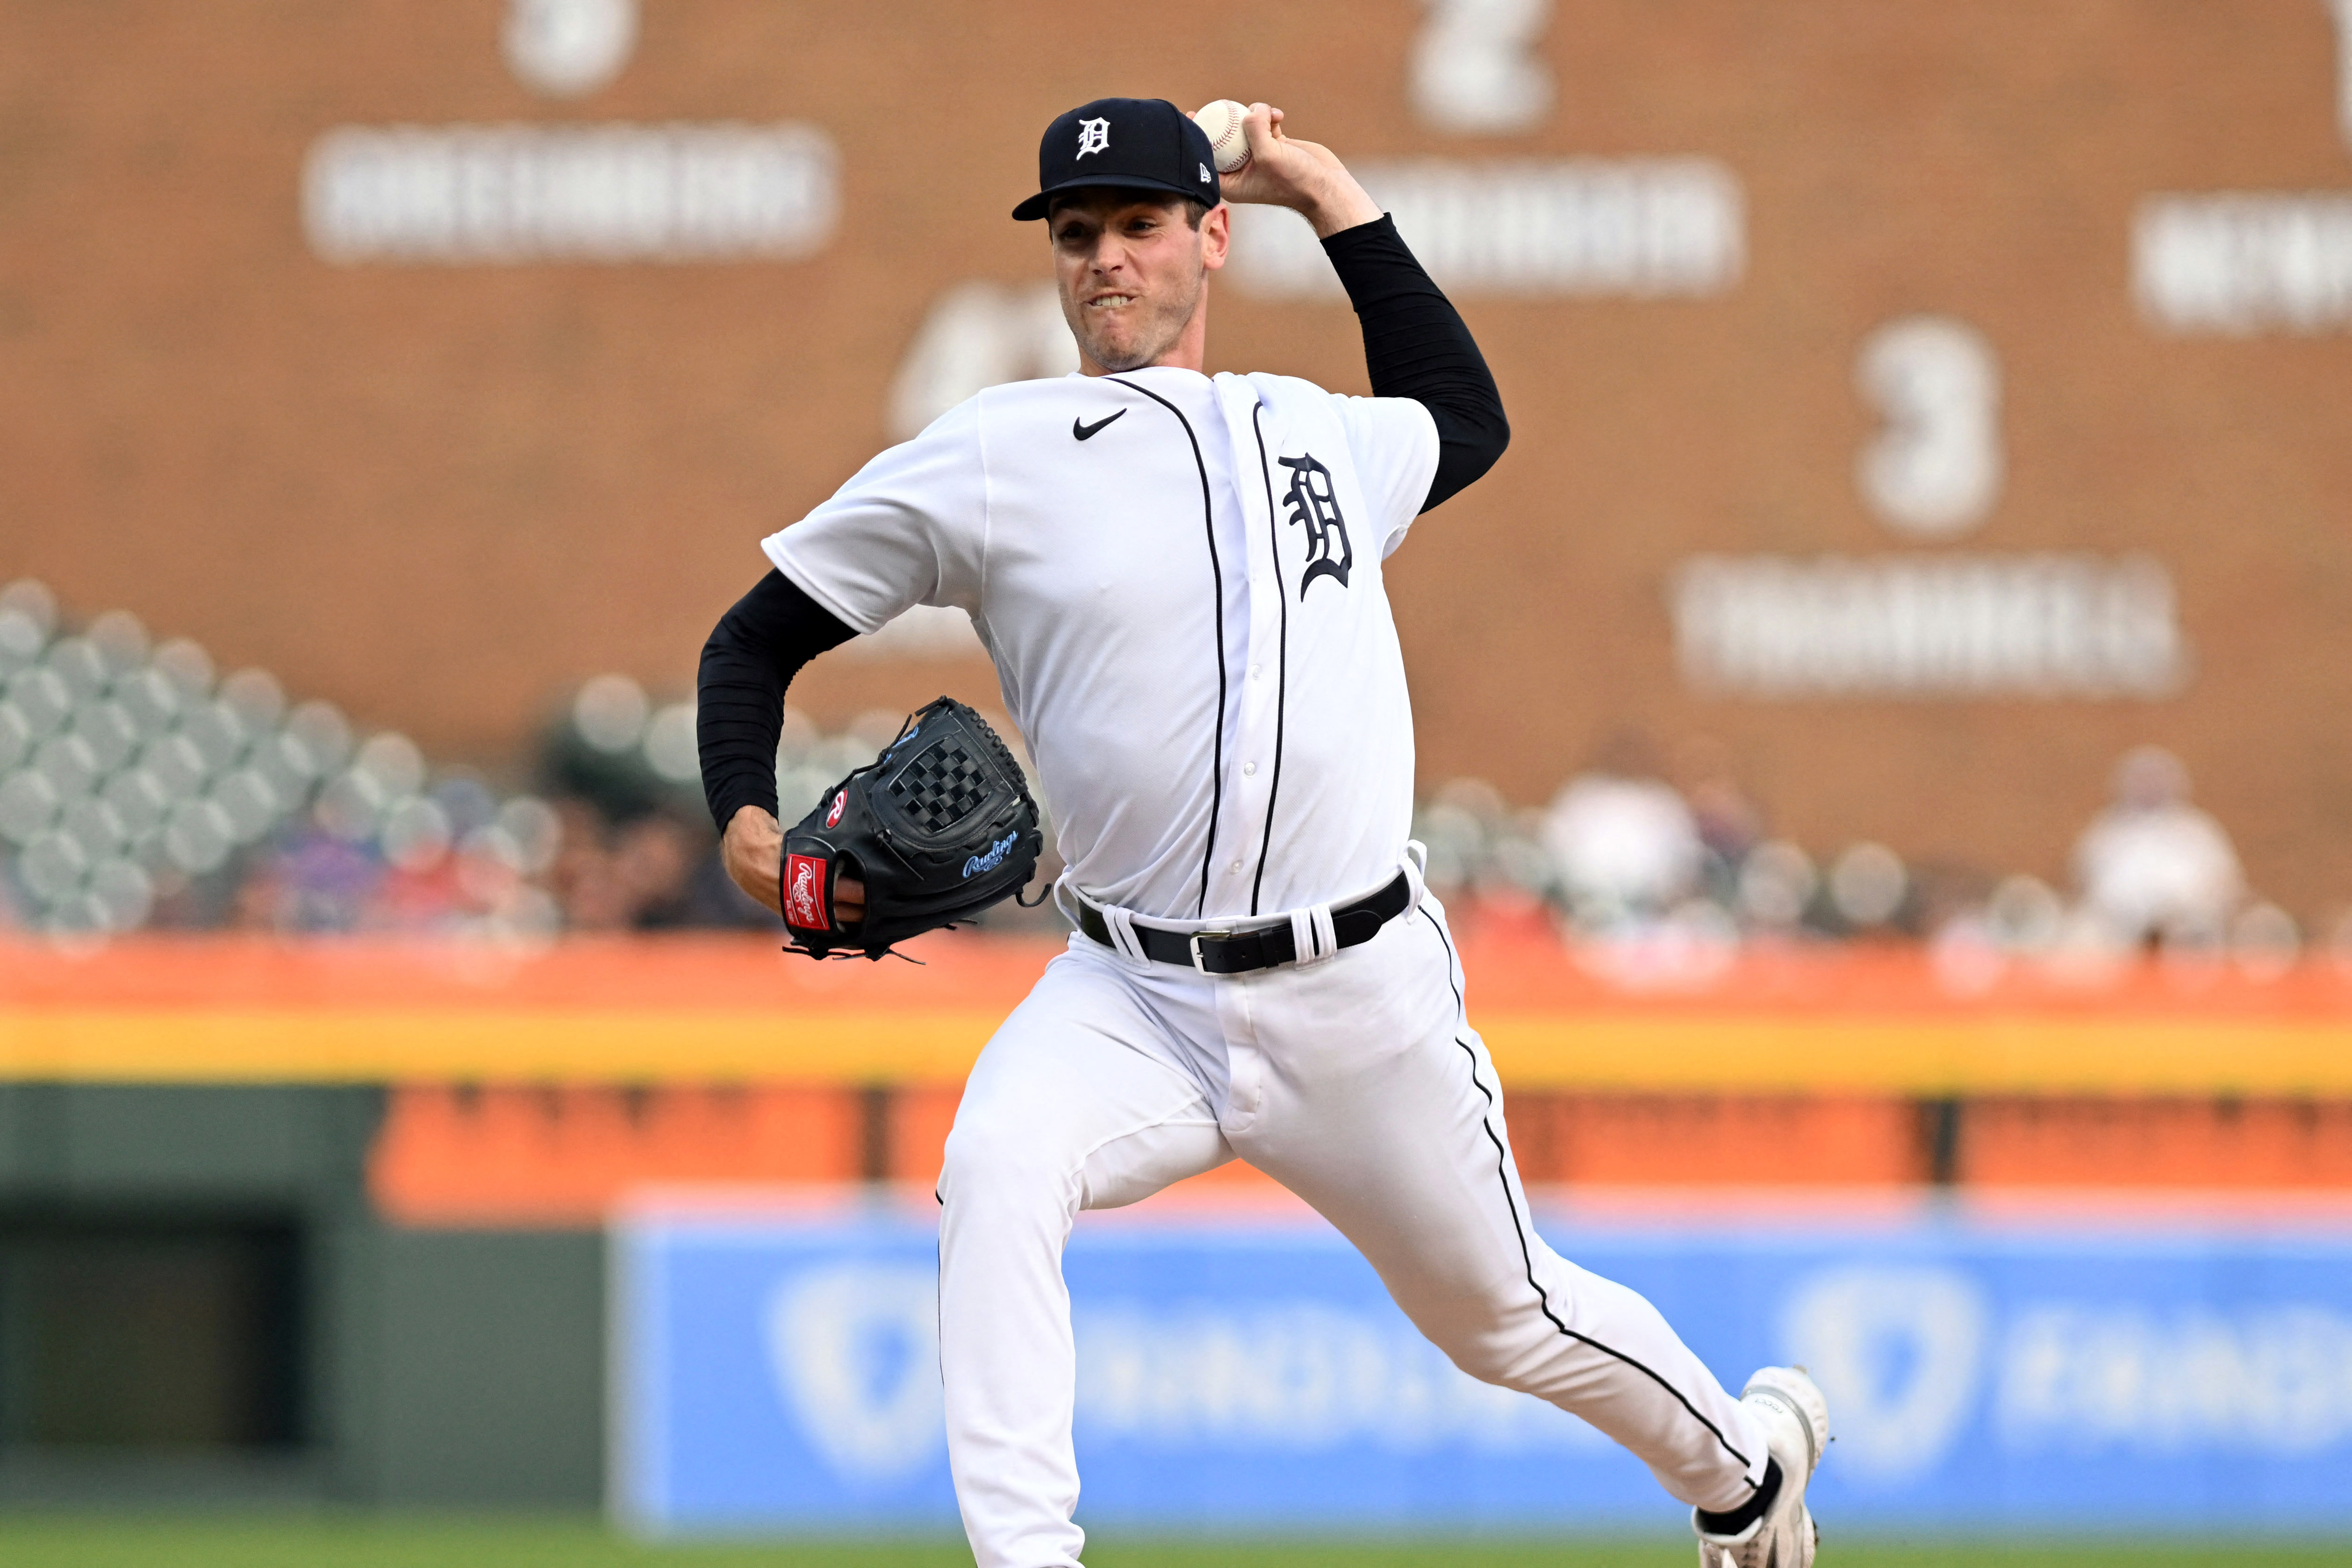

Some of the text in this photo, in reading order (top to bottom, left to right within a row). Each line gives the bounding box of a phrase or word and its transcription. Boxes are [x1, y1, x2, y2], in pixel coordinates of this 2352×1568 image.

[1076, 117, 1111, 160] D
[1857, 315, 2001, 535] 3
[1278, 452, 1352, 603] D
[963, 831, 1018, 878] Rawlings
[793, 862, 814, 923] Rawlings
